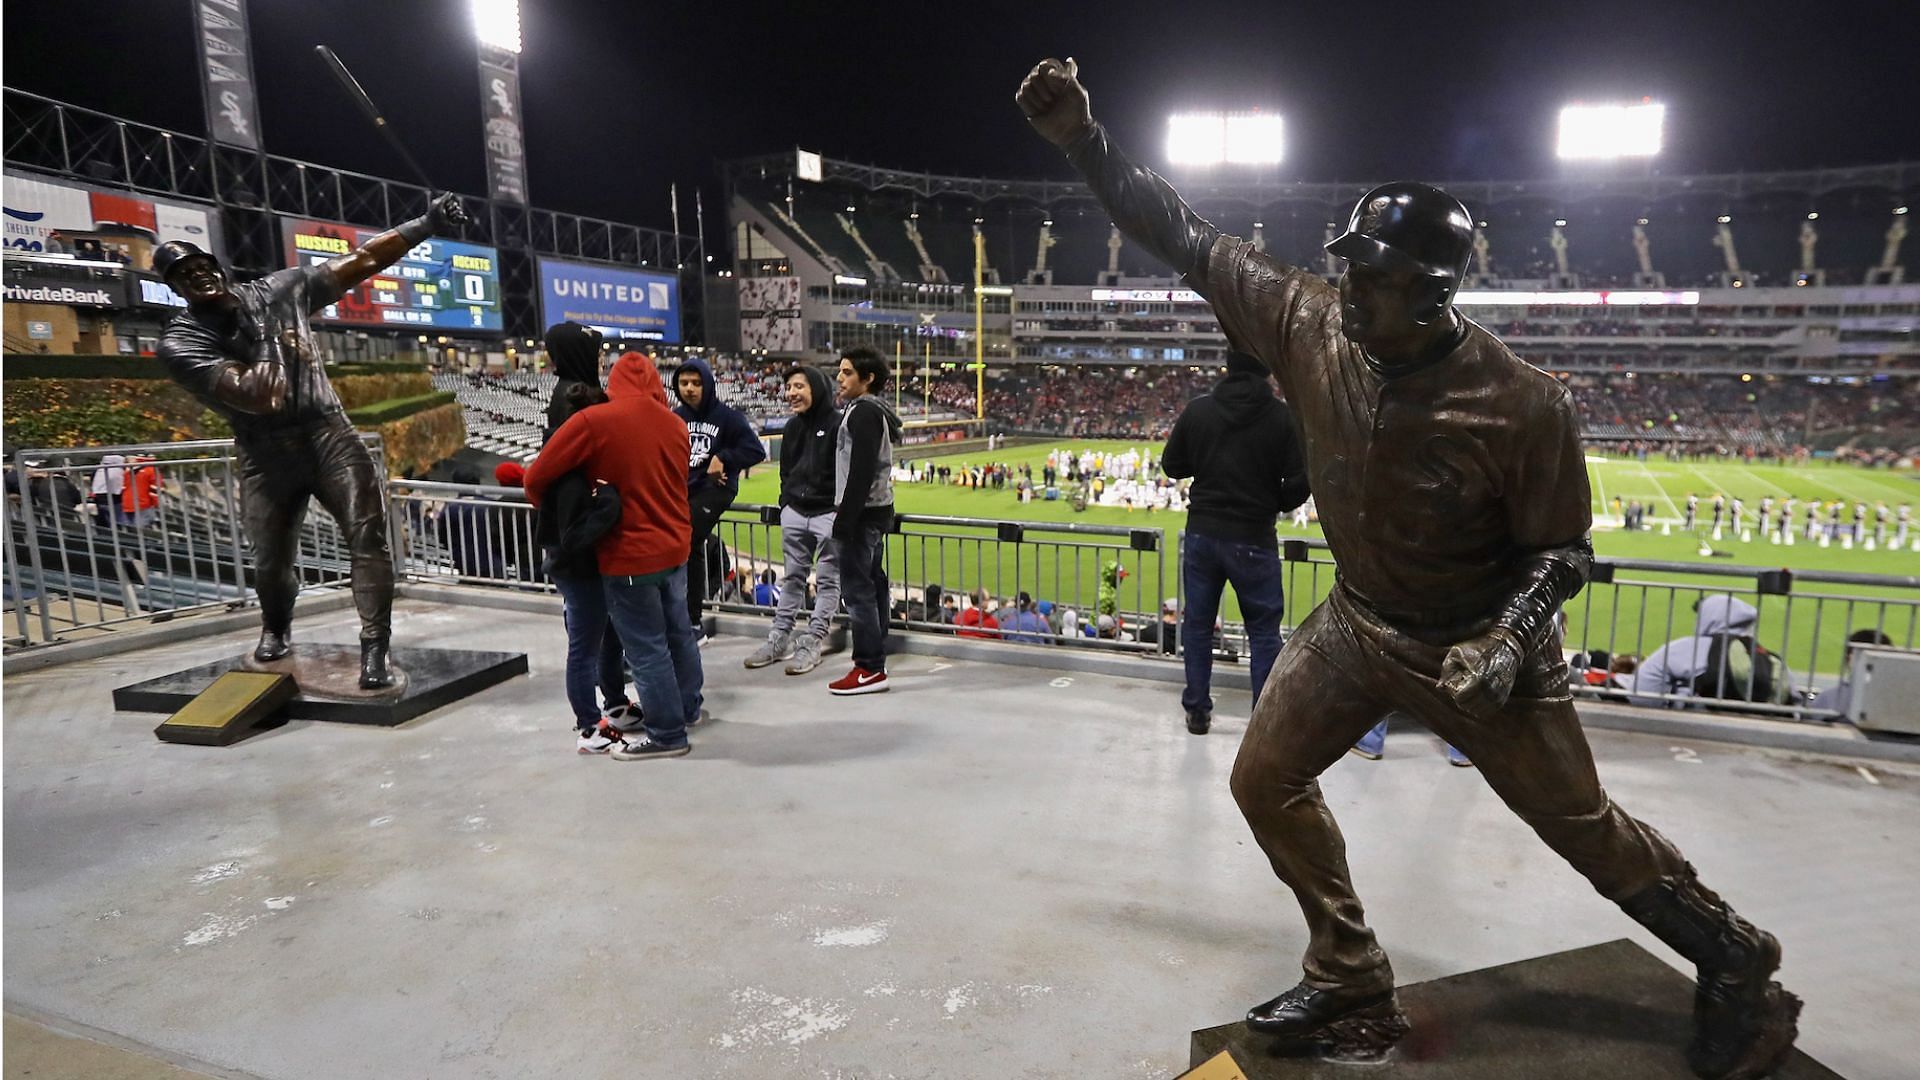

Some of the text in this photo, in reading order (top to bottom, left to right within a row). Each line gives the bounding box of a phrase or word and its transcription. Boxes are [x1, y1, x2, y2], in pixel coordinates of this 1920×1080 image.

[295, 233, 350, 255] HUSKIES
[452, 254, 491, 273] ROCKETS
[464, 274, 485, 301] 0
[553, 278, 645, 303] UNITED
[687, 421, 720, 438] LIFORNIA
[1669, 745, 1704, 764] 2
